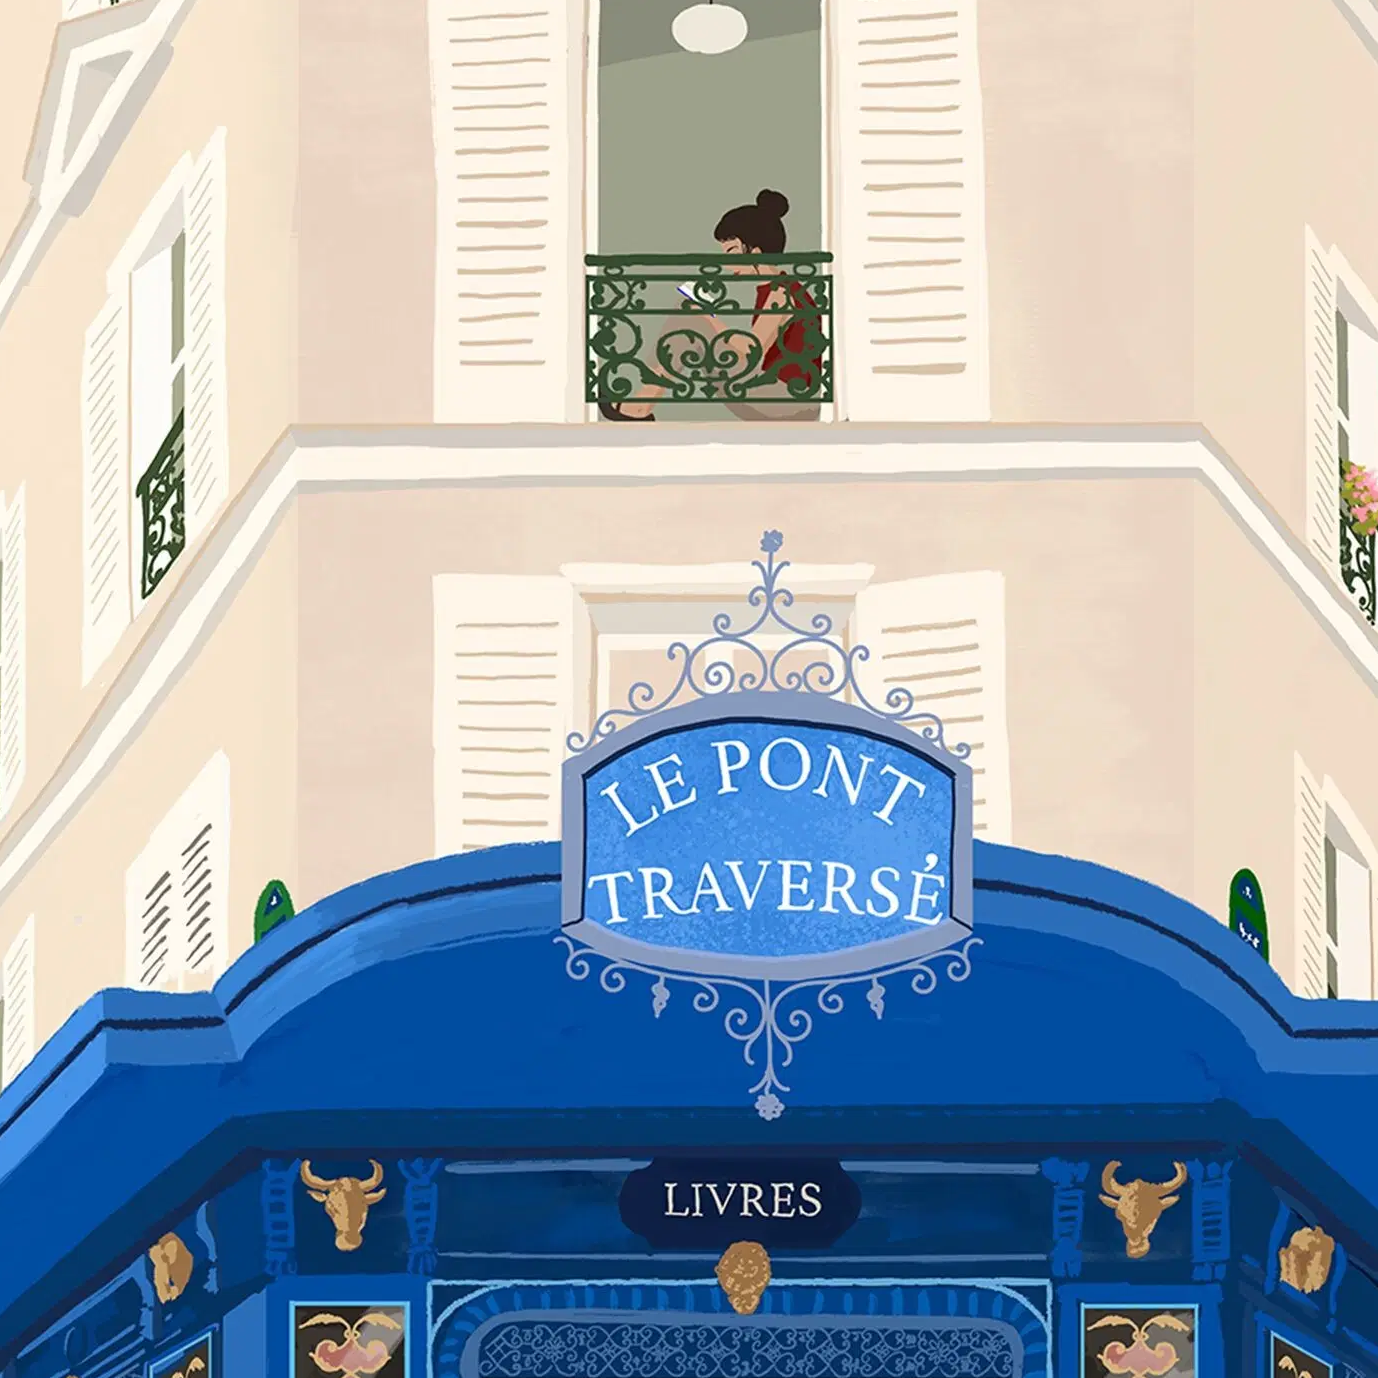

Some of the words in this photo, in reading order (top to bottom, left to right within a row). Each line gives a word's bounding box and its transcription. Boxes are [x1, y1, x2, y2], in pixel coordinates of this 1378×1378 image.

[599, 752, 697, 838] LE
[710, 736, 926, 827] PONT
[587, 852, 946, 926] TRAVERSÉ
[663, 1181, 823, 1218] LIVRES
